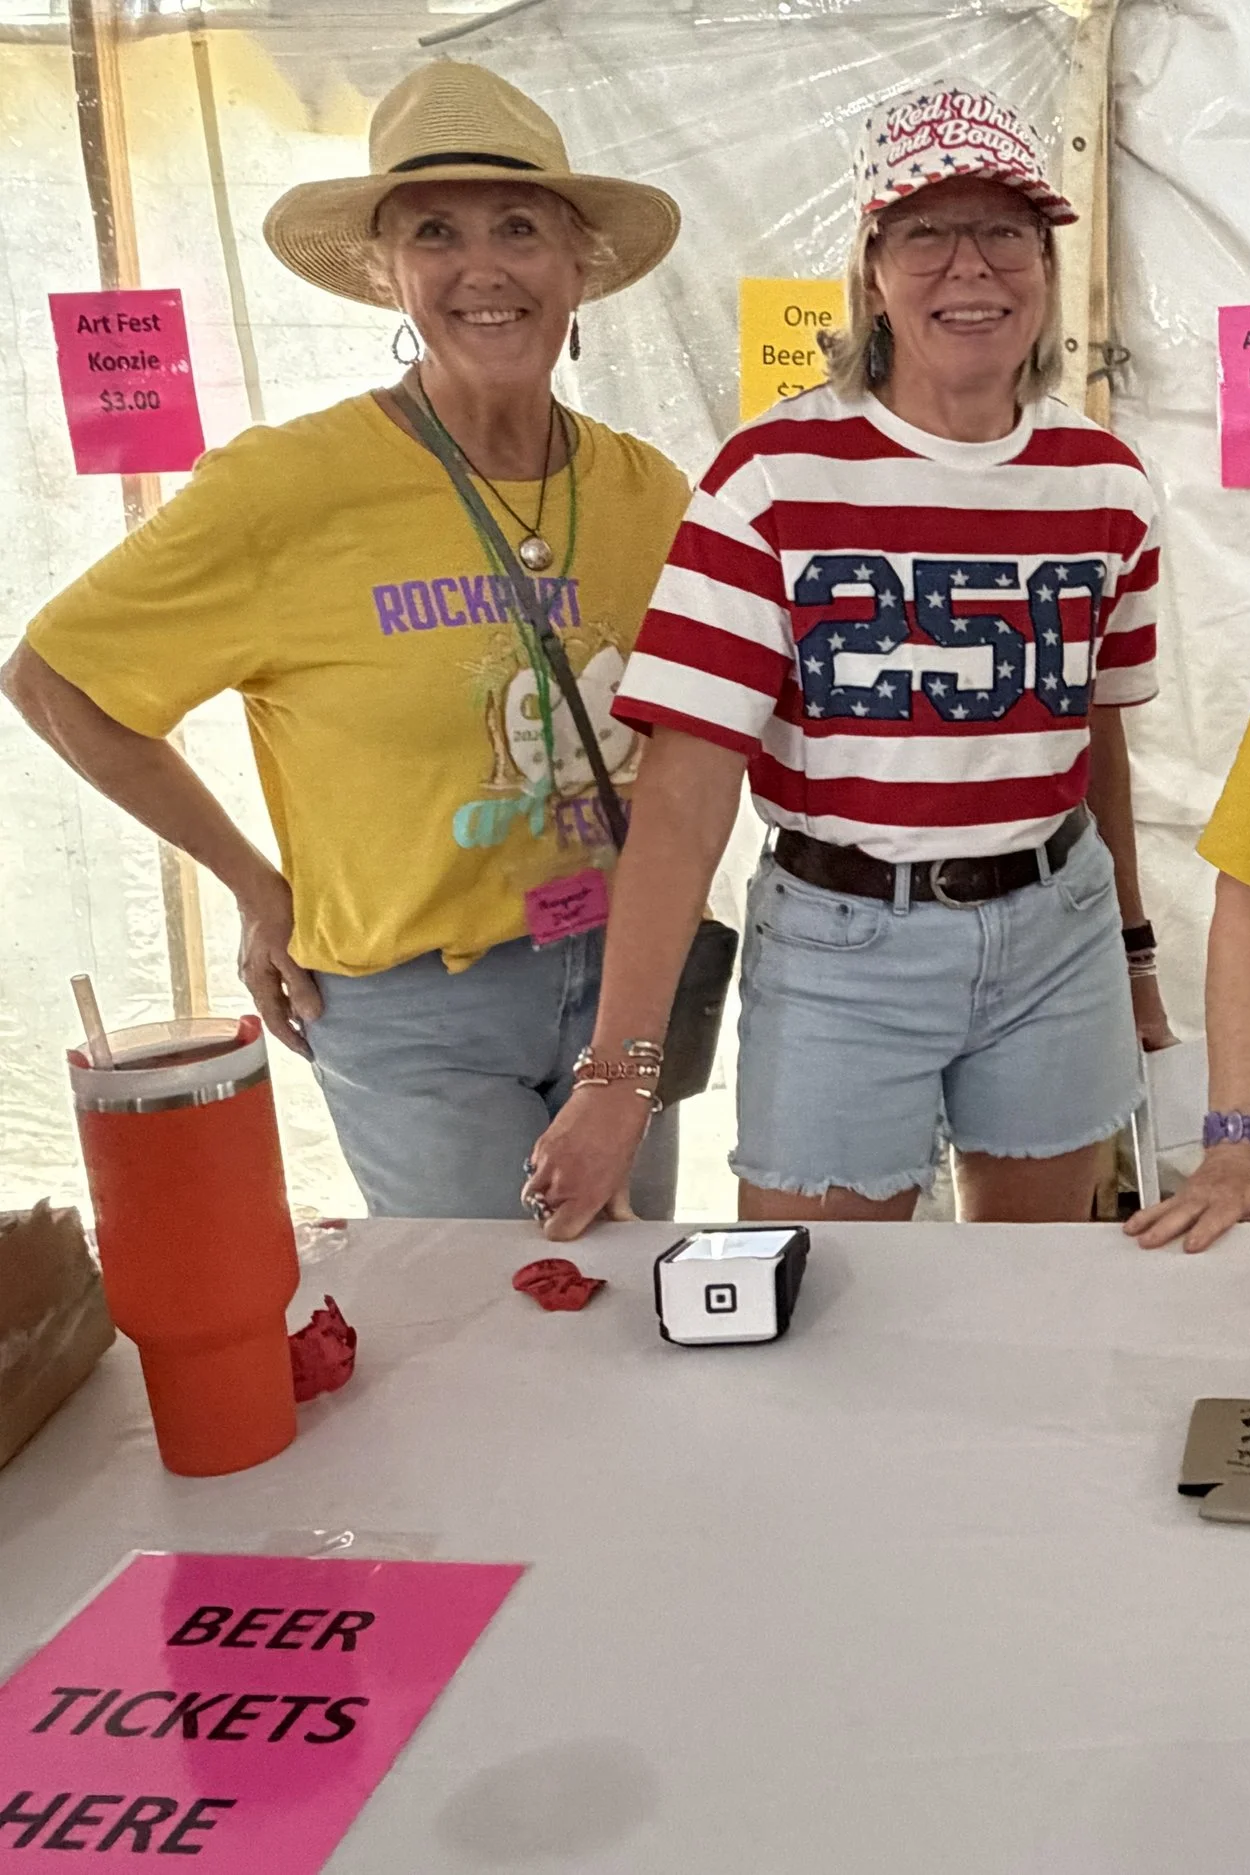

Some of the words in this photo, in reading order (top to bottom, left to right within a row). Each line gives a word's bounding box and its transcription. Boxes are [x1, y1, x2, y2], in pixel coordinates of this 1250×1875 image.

[952, 93, 1035, 154] White
[887, 126, 934, 167] and
[77, 314, 109, 334] Art
[117, 313, 161, 333] Fest
[784, 305, 832, 327] One
[89, 351, 161, 373] Koozie
[762, 345, 816, 366] Beer
[100, 390, 161, 412] $3.00
[373, 575, 581, 636] ROCKPRT
[795, 554, 1108, 722] 250
[167, 1606, 376, 1652] BEER
[31, 1687, 370, 1744] TICKETS
[0, 1791, 238, 1855] HERE
